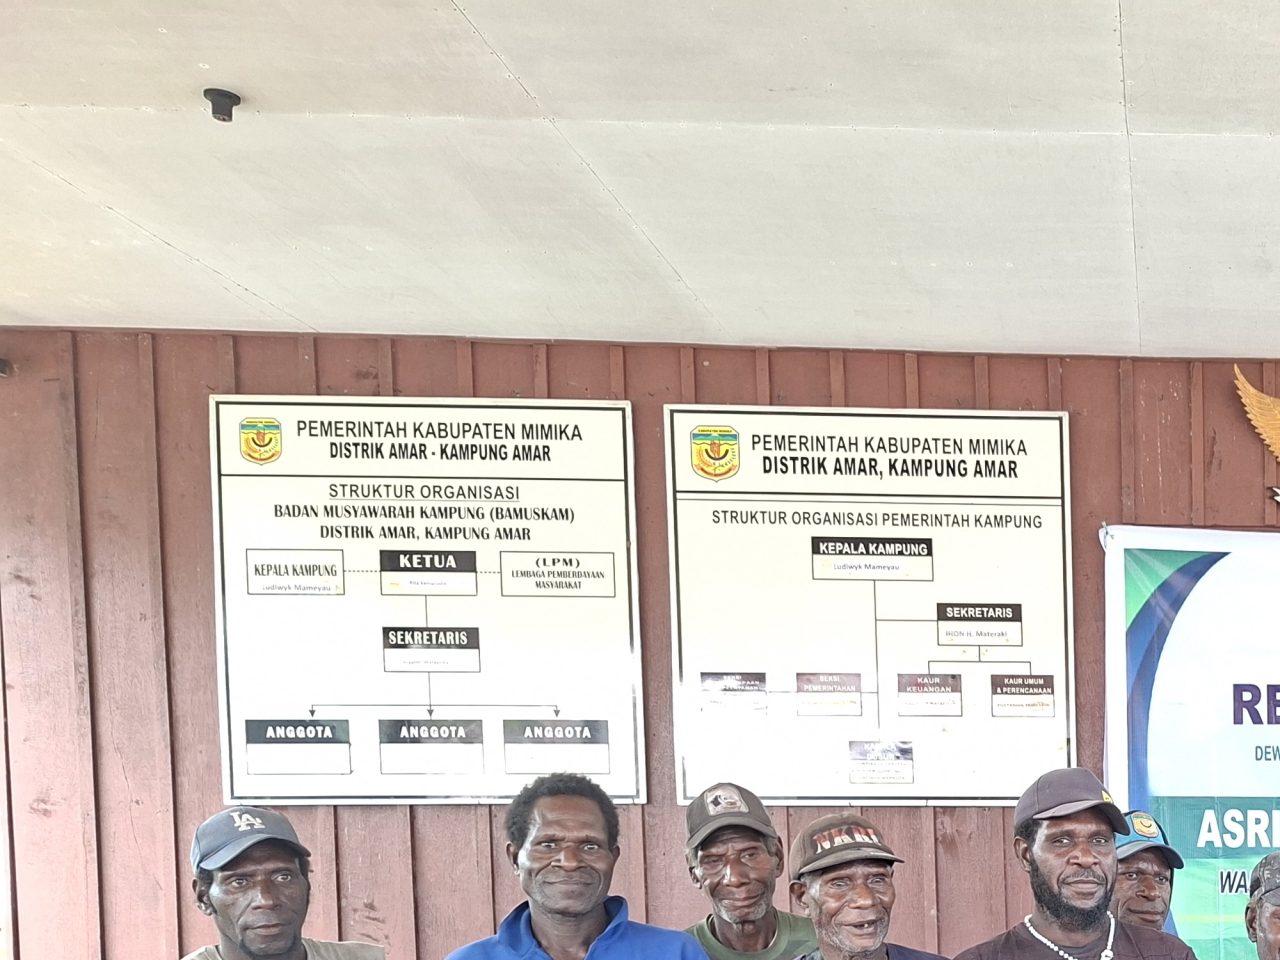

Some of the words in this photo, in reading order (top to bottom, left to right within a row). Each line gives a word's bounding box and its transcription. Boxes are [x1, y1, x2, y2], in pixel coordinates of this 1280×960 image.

[297, 420, 409, 439] PEMERINTAH
[413, 422, 516, 440] KABUPATEN
[521, 423, 582, 441] MIMIKA
[330, 442, 384, 460] DISTRIK
[389, 443, 428, 461] AMAR
[440, 444, 508, 462] KAMPUNG
[512, 444, 551, 462] AMAR
[752, 434, 859, 453] PEMERINTAH
[864, 436, 963, 455] KABUPATEN
[969, 438, 1027, 456] MIMIKA
[763, 456, 827, 475] DISTRIK
[833, 457, 884, 480] AMAR,
[888, 458, 968, 478] KAMPUNG
[973, 460, 1018, 478] AMAR
[329, 484, 415, 499] STRUKTUR
[420, 485, 520, 500] ORGANISASI
[274, 505, 318, 519] BADAN
[324, 505, 415, 520] MUSYAWARAH
[420, 506, 484, 521] KAMPUNG
[490, 507, 575, 523] (BAMUSKAM)
[712, 510, 787, 525] STRUKTUR
[791, 511, 878, 527] ORGANISASI
[882, 512, 970, 528] PEMERINTAH
[974, 514, 1043, 529] KAMPUNG
[320, 526, 374, 539] DISTRIK
[379, 526, 420, 541] AMAR,
[425, 527, 489, 541] KAMPUNG
[494, 527, 531, 541] AMAR
[819, 541, 866, 555] KEPALA
[868, 542, 928, 556] KAMPUNG
[400, 554, 457, 568] KETUA
[535, 557, 581, 568] (LPM)
[254, 564, 289, 576] KEPALA
[292, 564, 337, 577] KAMPUNG
[511, 570, 546, 579] LEMBAGA
[547, 570, 605, 579] PEMBERDAYAAN
[535, 581, 582, 590] MASYARAKAT
[946, 607, 1012, 618] SEKRETARIS
[388, 631, 468, 645] SEKRETARIS
[266, 725, 333, 739] ANGGOTA
[400, 726, 466, 739] ANGGOTA
[524, 725, 592, 739] ANGGOTA
[230, 811, 265, 832] LA
[1197, 808, 1280, 848] ASRI
[813, 826, 882, 855] NKRI
[1220, 871, 1250, 893] WA
